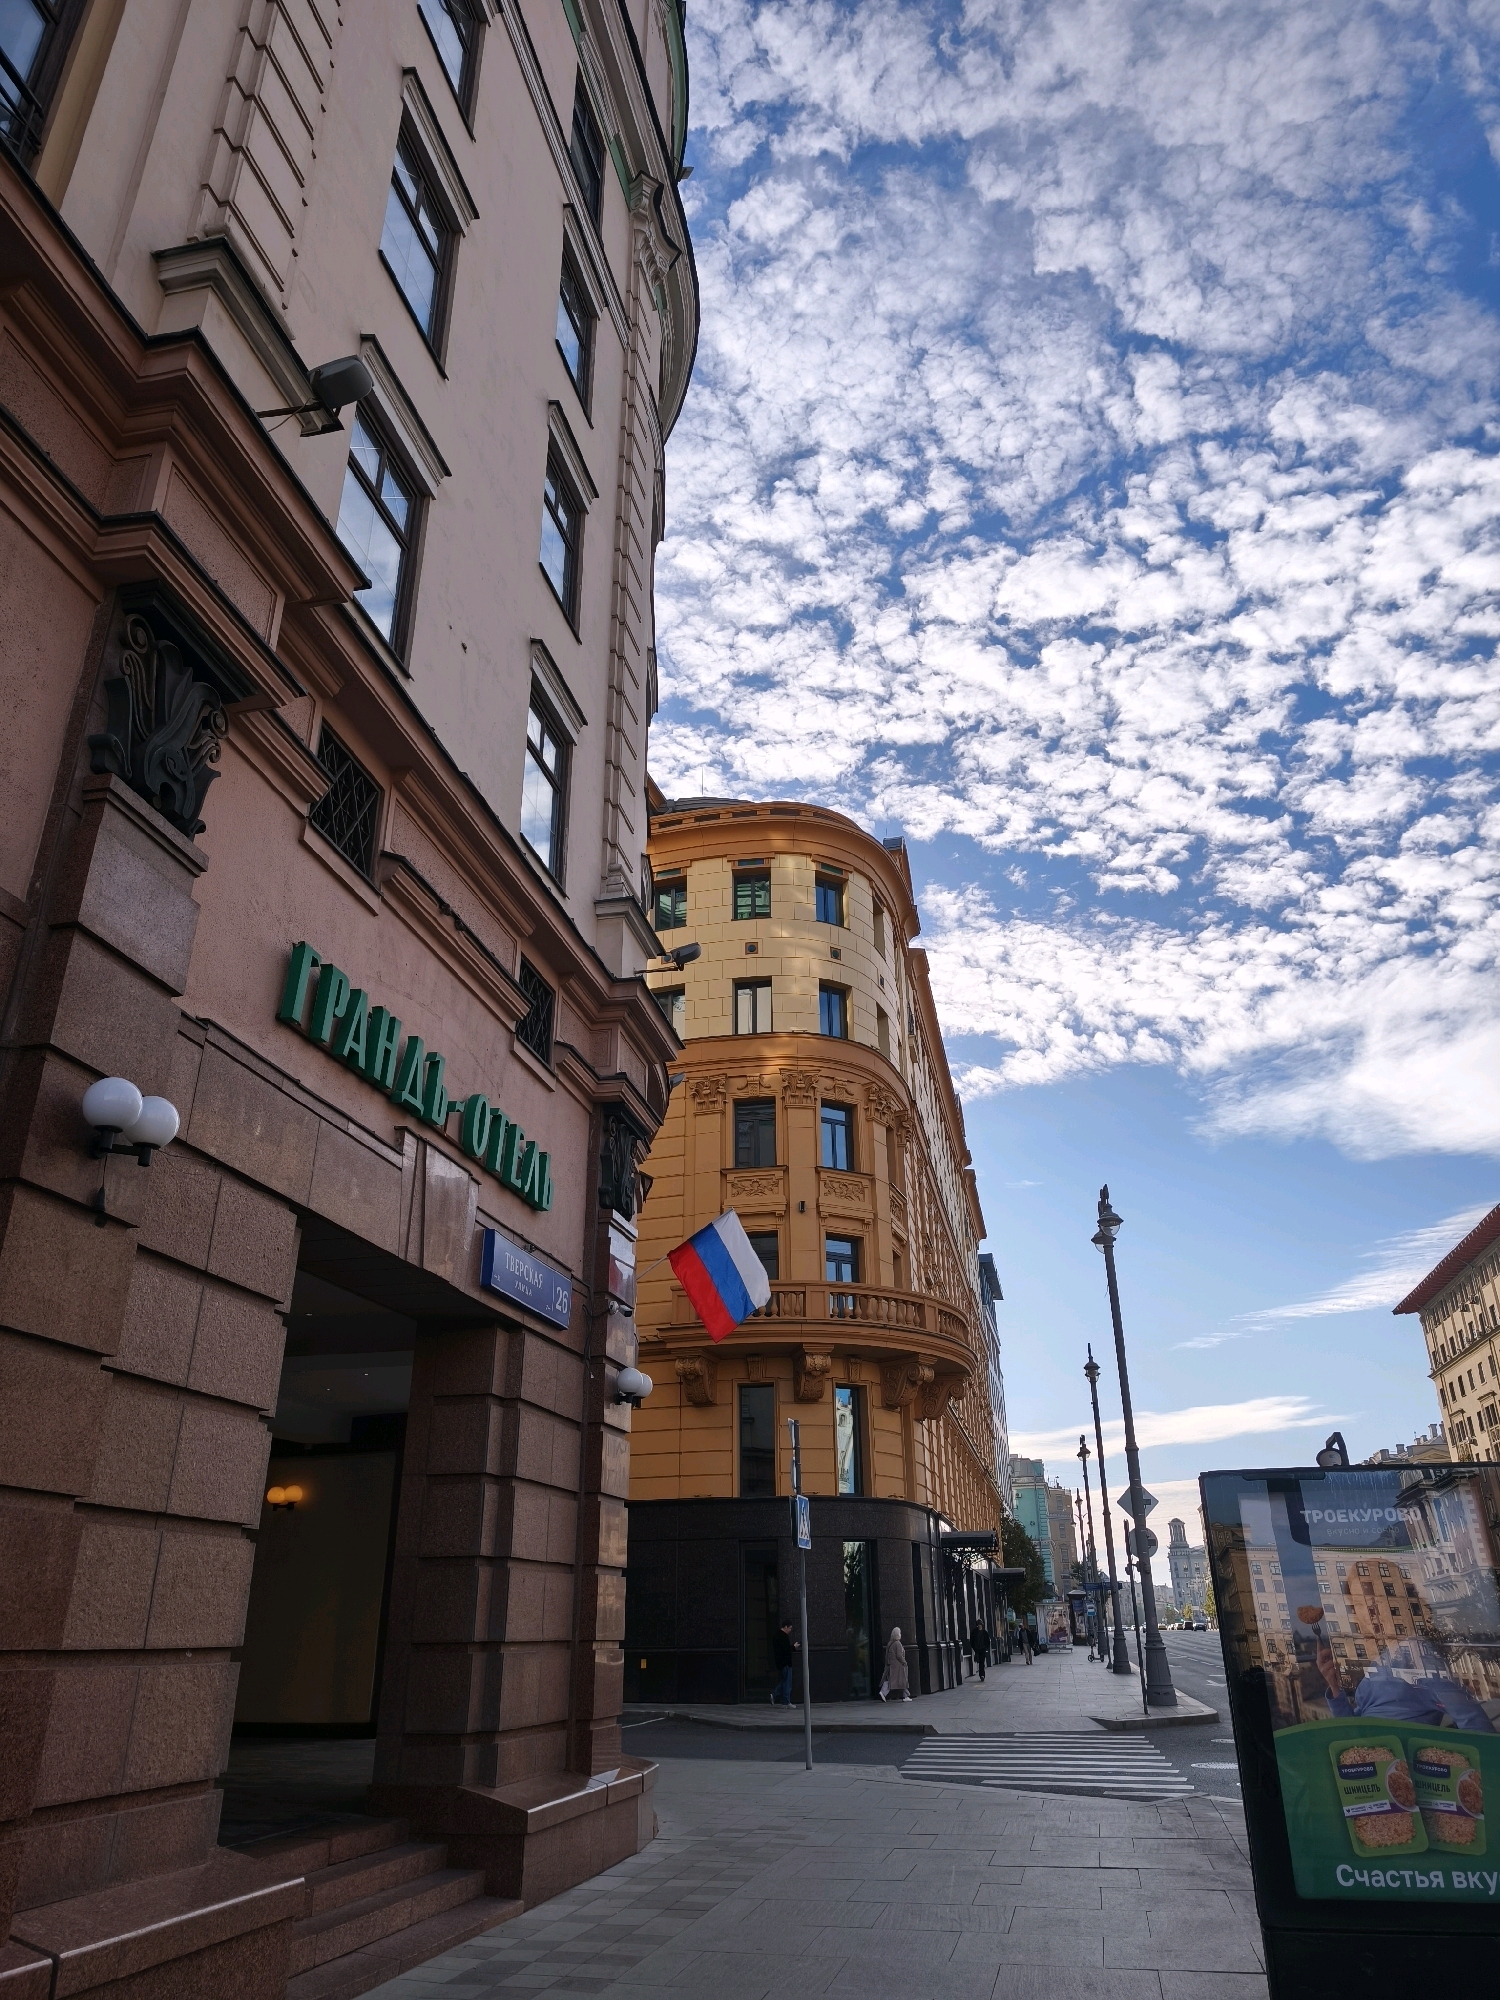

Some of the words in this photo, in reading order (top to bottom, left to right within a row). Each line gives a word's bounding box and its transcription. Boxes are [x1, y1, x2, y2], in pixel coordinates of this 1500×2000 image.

[279, 940, 554, 1212] ГРАНДЪ-ОТЕЛЬ
[504, 1251, 544, 1290] ТВЕРСКАЯ
[555, 1286, 569, 1314] 26
[1300, 1507, 1421, 1524] ТРОЕКУРОВО
[1344, 1783, 1381, 1795] ШНИЦЕЛЬ
[1415, 1779, 1451, 1793] ШНИЦЕЛЬ
[1336, 1864, 1445, 1888] Счастья
[1451, 1871, 1500, 1896] вку
